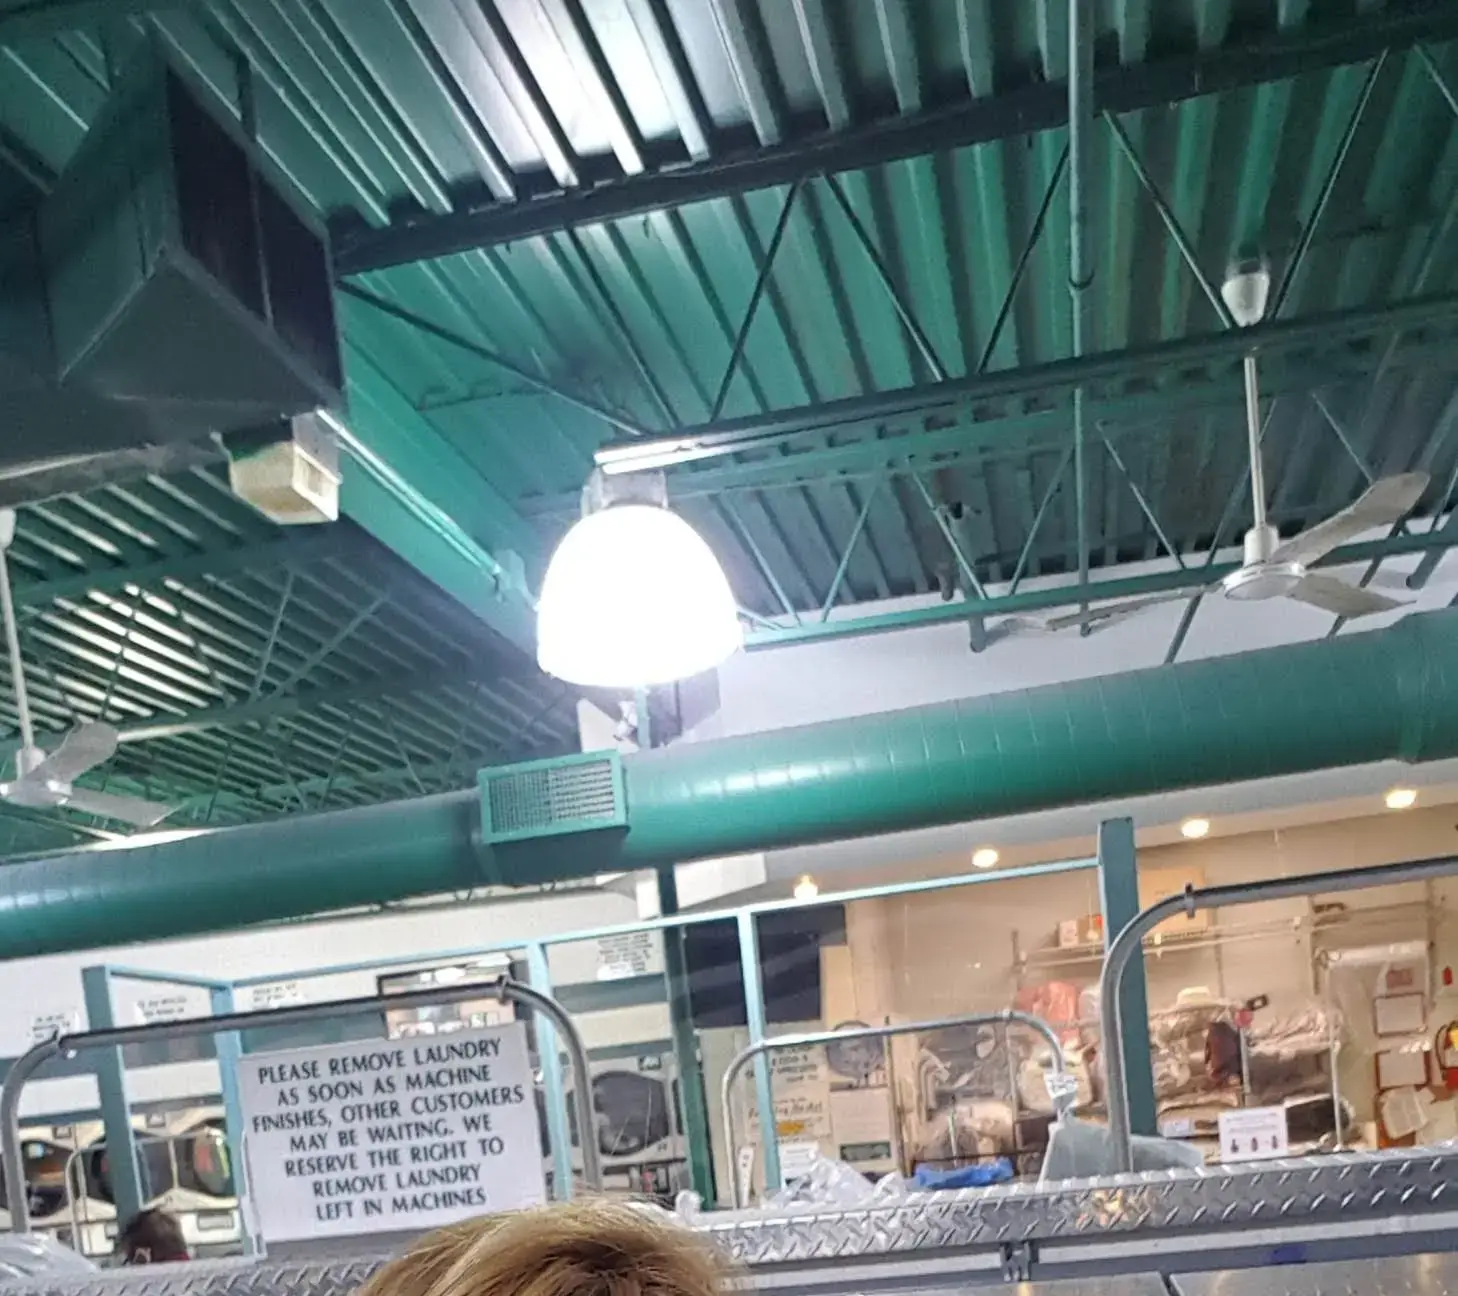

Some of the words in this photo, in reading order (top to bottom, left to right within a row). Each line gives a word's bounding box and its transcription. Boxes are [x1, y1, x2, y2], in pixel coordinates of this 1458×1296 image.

[258, 1060, 321, 1084] PLEASE
[329, 1050, 406, 1076] REMOVE
[414, 1038, 502, 1066] LAUNDRY
[277, 1087, 300, 1107] AS
[308, 1082, 364, 1102] SOON
[373, 1075, 397, 1094] AS
[406, 1064, 492, 1091] MACHINE
[252, 1109, 332, 1133] FINISHES,
[340, 1099, 402, 1123] OTHER
[411, 1085, 525, 1115] CUSTOMERS
[289, 1133, 335, 1153] MAY
[338, 1128, 359, 1147] BE
[462, 1114, 493, 1132] WE
[285, 1154, 358, 1178] RESERVE
[369, 1149, 401, 1169] THE
[410, 1141, 467, 1165] RIGHT
[477, 1136, 505, 1156] TO
[313, 1173, 388, 1197] REMOVE
[396, 1163, 482, 1190] LAUNDRY
[316, 1200, 353, 1221] LEFT
[364, 1198, 383, 1215] IN
[392, 1187, 486, 1213] MACHINES
